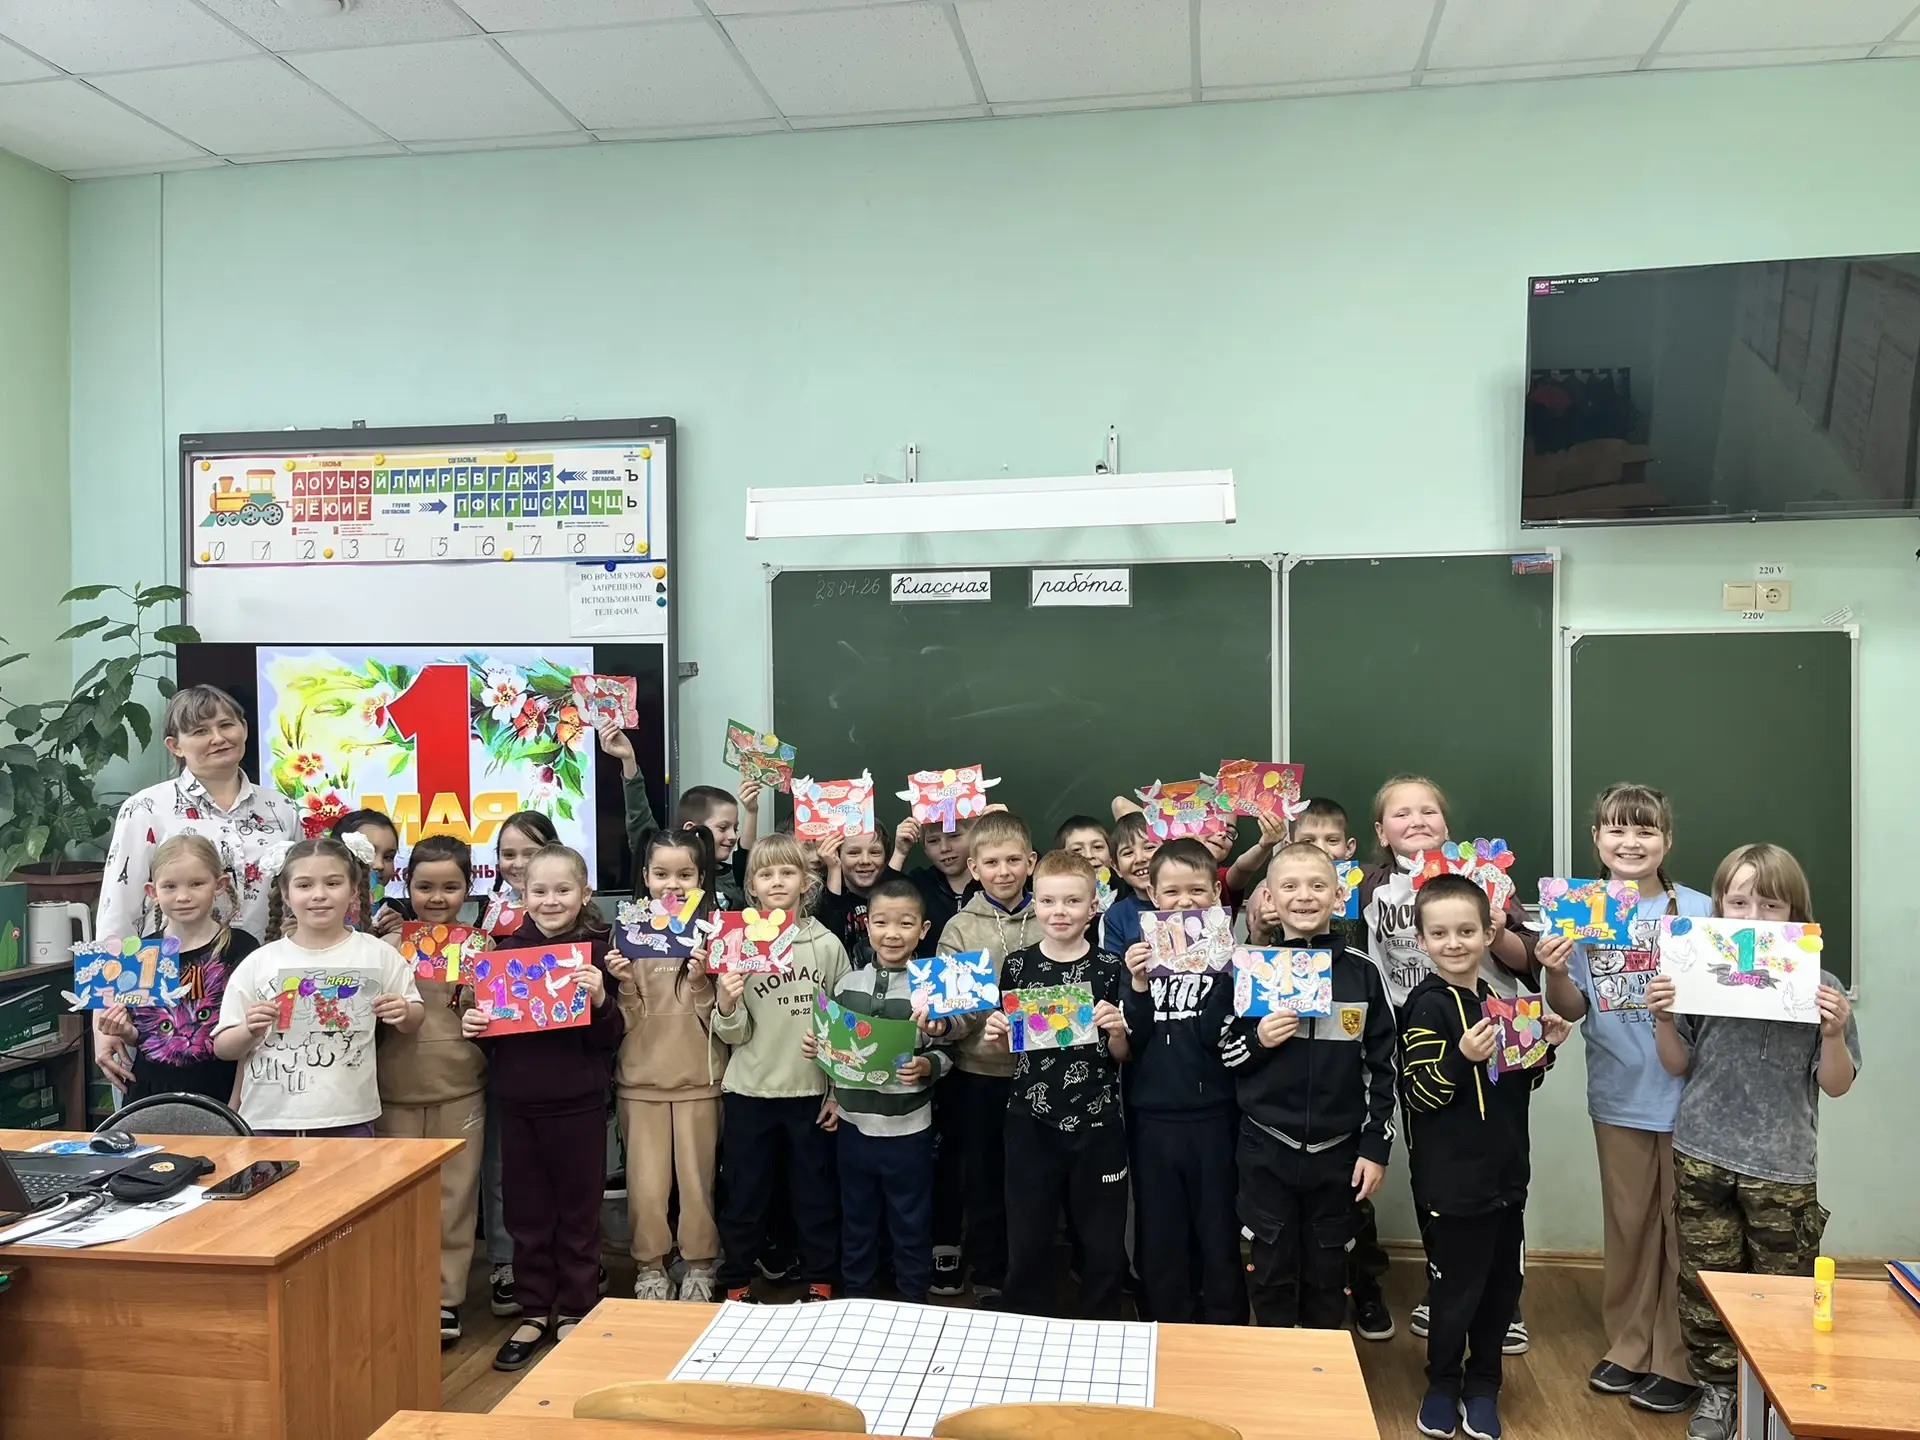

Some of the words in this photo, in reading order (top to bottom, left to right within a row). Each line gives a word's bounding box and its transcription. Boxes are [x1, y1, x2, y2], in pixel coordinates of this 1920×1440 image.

[294, 478, 304, 491] А
[309, 477, 320, 490] О
[325, 476, 335, 489] У
[340, 476, 354, 489] Ы
[359, 476, 370, 489] Э
[376, 473, 386, 488] Й
[392, 475, 403, 488] Л
[409, 475, 420, 488] М
[425, 474, 435, 487] Н
[441, 474, 451, 487] Р
[457, 473, 466, 486] Б
[473, 473, 483, 486] В
[492, 473, 501, 485] Г
[507, 473, 519, 487] Д
[523, 472, 538, 485] Ж
[542, 471, 551, 484] З
[625, 469, 639, 482] Ъ
[294, 503, 304, 516] Я
[309, 500, 319, 516] Ё
[324, 502, 339, 515] Ю
[342, 502, 353, 515] И
[359, 501, 369, 514] Е
[457, 499, 466, 511] П
[471, 498, 485, 512] Ф
[491, 498, 500, 511] К
[508, 498, 519, 511] Т
[523, 498, 538, 511] Ш
[542, 497, 552, 510] С
[557, 496, 568, 510] Х
[573, 495, 585, 511] Ц
[591, 495, 602, 508] Ч
[607, 495, 622, 511] Щ
[627, 496, 637, 508] Ь
[214, 541, 225, 560] 0
[262, 541, 271, 560] 1
[303, 540, 315, 559] 2
[349, 538, 359, 558] 3
[393, 538, 405, 558] 4
[437, 537, 448, 556] 5
[482, 535, 495, 556] 6
[530, 535, 542, 555] 7
[573, 533, 586, 553] 8
[622, 533, 635, 553] 9
[581, 573, 593, 581] ВО
[594, 572, 622, 580] ВРЕМЯ
[625, 571, 652, 579] УРОКА
[1759, 566, 1774, 574] 220
[1776, 566, 1784, 574] V
[592, 582, 642, 591] ЗАПРЕЩЕНО
[816, 577, 881, 600] 28.04.26
[893, 576, 989, 595] Классная
[581, 595, 653, 605] ИСПОЛЬЗОВАНИЕ
[593, 607, 639, 617] ТЕЛЕФОНА
[1742, 611, 1765, 620] 220V
[385, 663, 471, 849] 1
[936, 787, 957, 797] МАЯ
[1172, 801, 1194, 811] МАЯ
[1236, 799, 1259, 816] МАЯ
[360, 792, 519, 847] МАЯ
[1574, 925, 1601, 938] МАЯ
[636, 931, 661, 947] МАЯ
[1730, 927, 1755, 972] 1
[136, 945, 160, 988] 1
[441, 943, 460, 982] 1
[736, 959, 760, 970] МАЯ
[325, 975, 353, 986] МАЯ
[487, 973, 508, 1008] 1
[114, 992, 142, 1004] МАЯ
[777, 996, 789, 1006] TO
[794, 993, 813, 1003] RETR
[790, 1007, 811, 1017] 90-22
